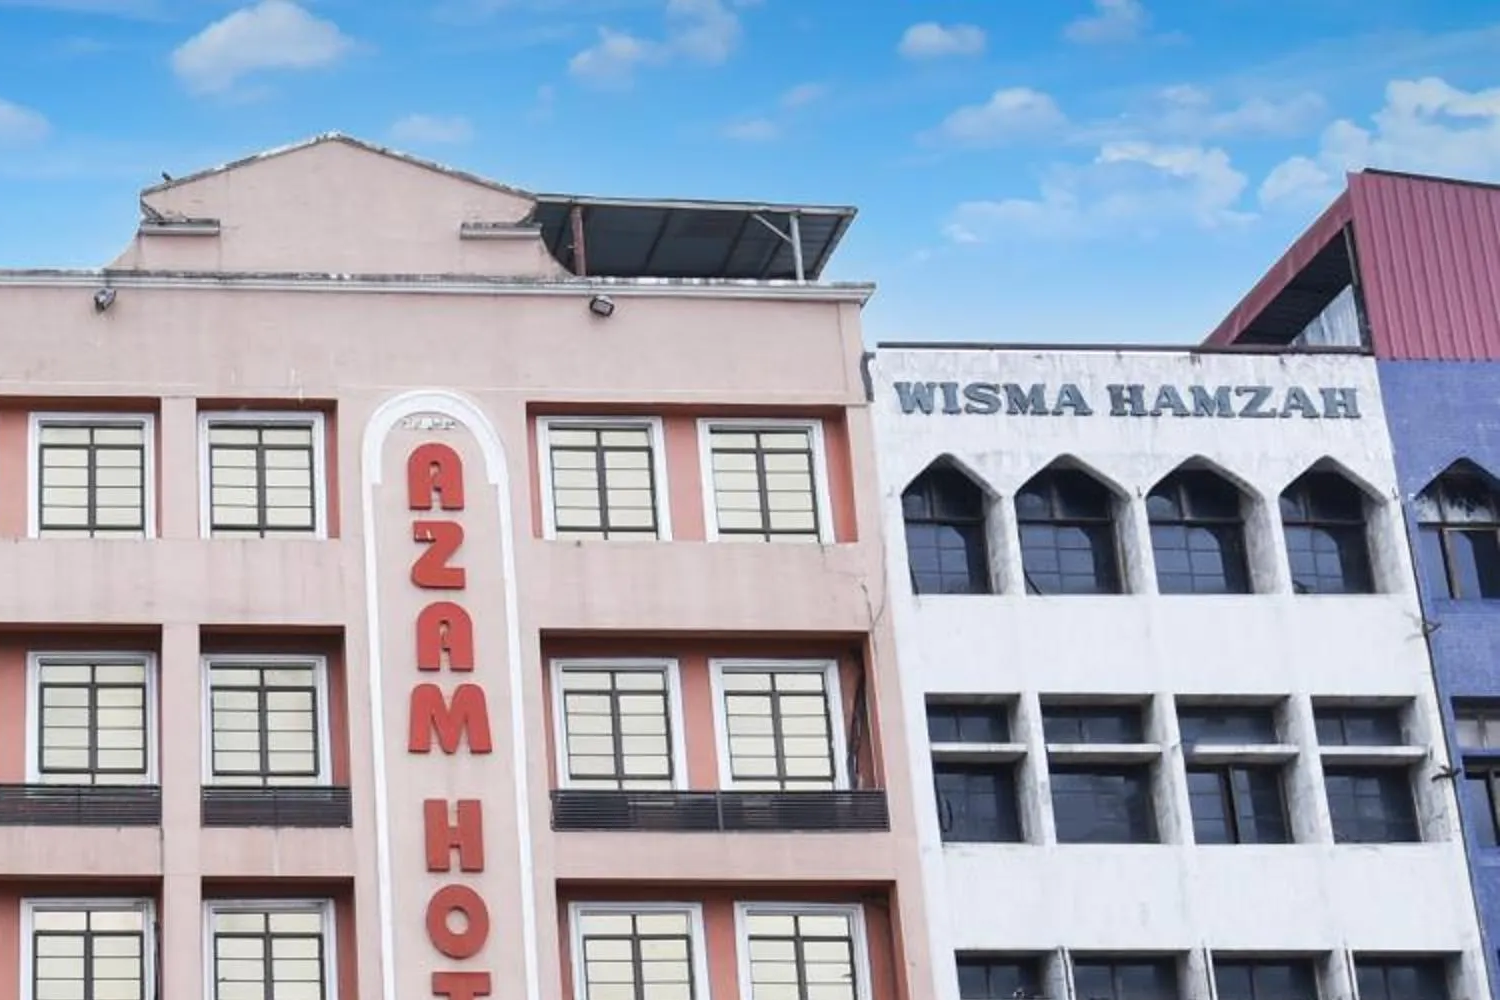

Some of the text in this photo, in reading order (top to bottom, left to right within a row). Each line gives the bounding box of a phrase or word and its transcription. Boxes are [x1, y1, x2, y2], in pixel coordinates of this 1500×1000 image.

[893, 381, 1364, 419] WISMA HAMZAH
[407, 442, 493, 754] AZAM
